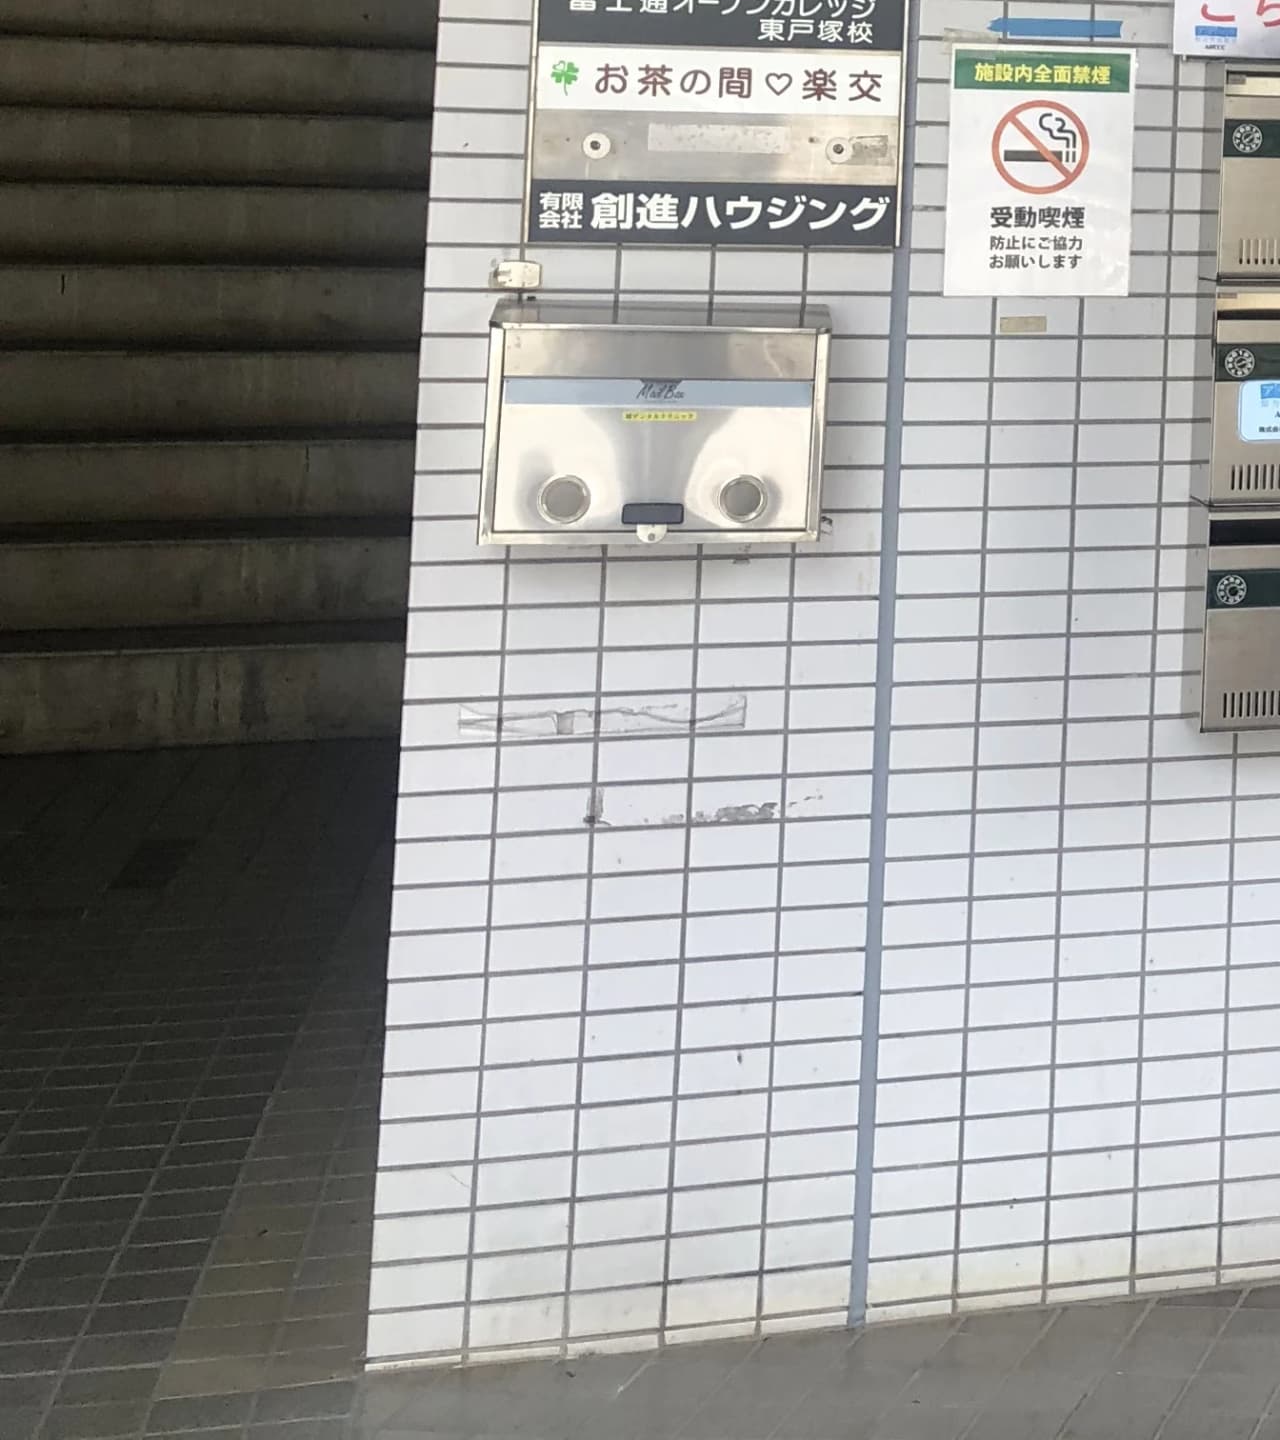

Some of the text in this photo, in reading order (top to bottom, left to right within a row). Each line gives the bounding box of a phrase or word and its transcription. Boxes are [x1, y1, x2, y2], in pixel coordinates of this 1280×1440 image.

[757, 17, 874, 45] 東戸塚校
[974, 61, 1111, 86] 施設内全面禁煙
[590, 192, 892, 233] 創進ハウジング
[989, 206, 1086, 230] 受動喫煙
[989, 235, 1084, 251] 防止にご協力
[988, 253, 1083, 270] お願いします
